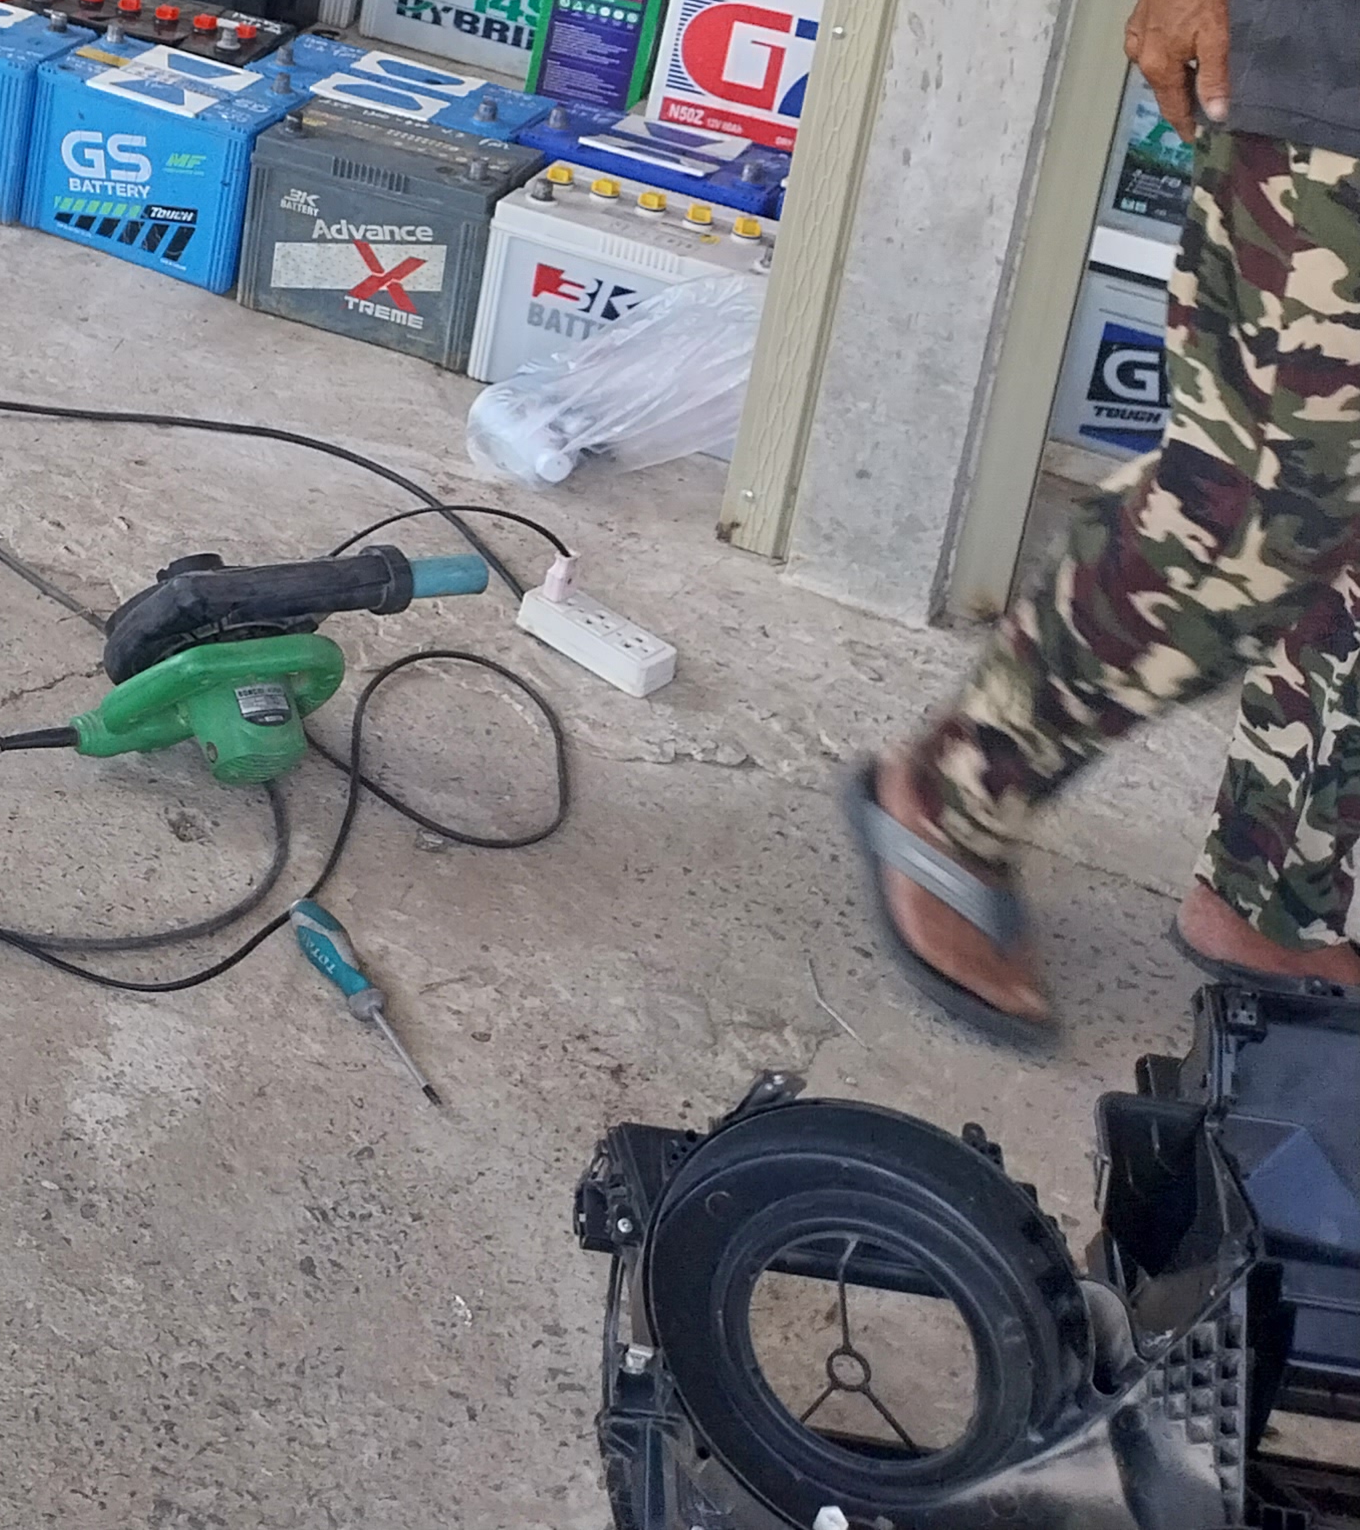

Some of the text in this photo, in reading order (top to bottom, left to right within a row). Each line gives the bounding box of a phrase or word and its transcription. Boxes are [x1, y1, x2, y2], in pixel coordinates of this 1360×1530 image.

[668, 104, 705, 126] N50Z
[61, 130, 152, 182] GS
[166, 153, 206, 169] MF
[69, 178, 151, 198] BATTERY
[288, 188, 321, 206] 3K
[148, 207, 195, 222] TOUGH
[280, 199, 319, 217] BATTERY
[312, 218, 434, 242] Advance
[344, 295, 425, 329] TREME
[527, 303, 614, 340] BATT
[1103, 350, 1160, 402] G
[1093, 406, 1162, 423] TOUGH
